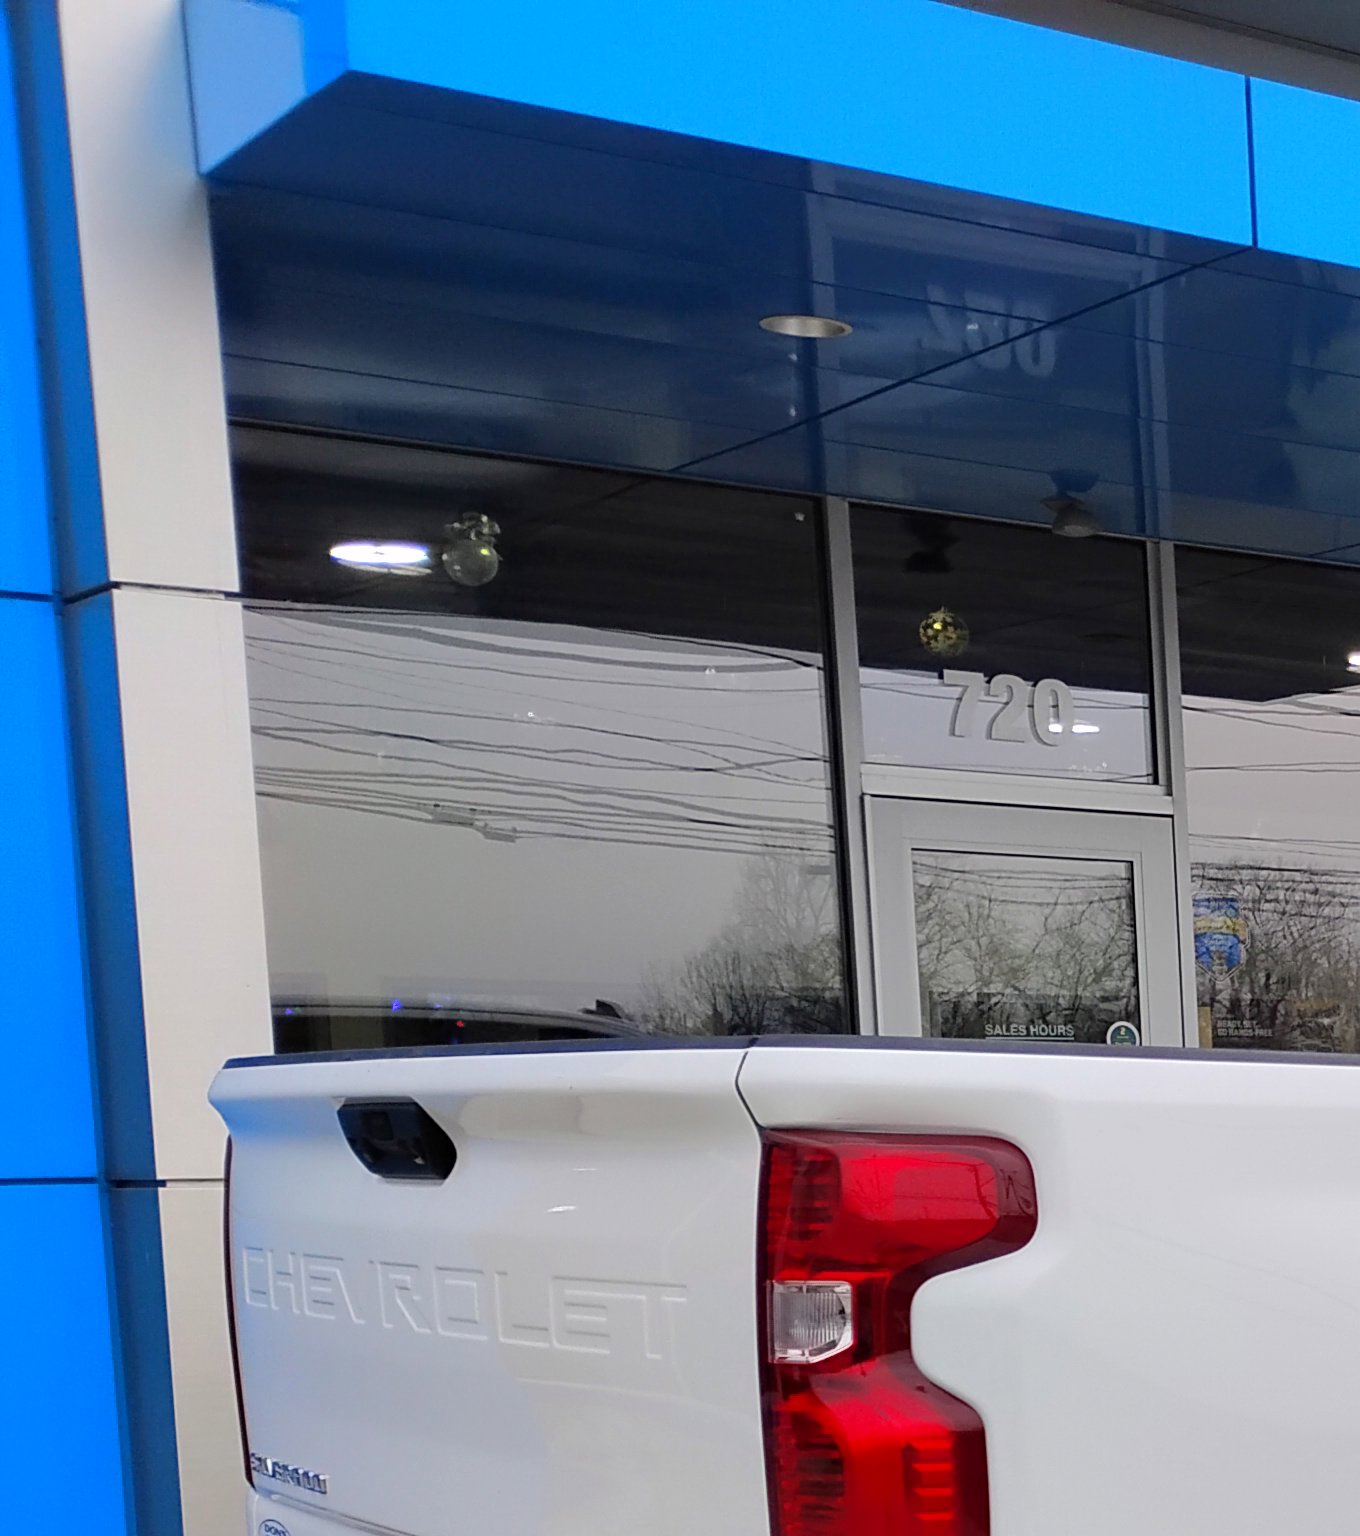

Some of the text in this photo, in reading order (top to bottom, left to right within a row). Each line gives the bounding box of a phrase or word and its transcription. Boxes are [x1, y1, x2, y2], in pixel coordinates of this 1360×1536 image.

[942, 668, 1075, 747] 720
[985, 1024, 1075, 1037] SALES HOURS
[243, 1246, 688, 1361] CHEVROLET
